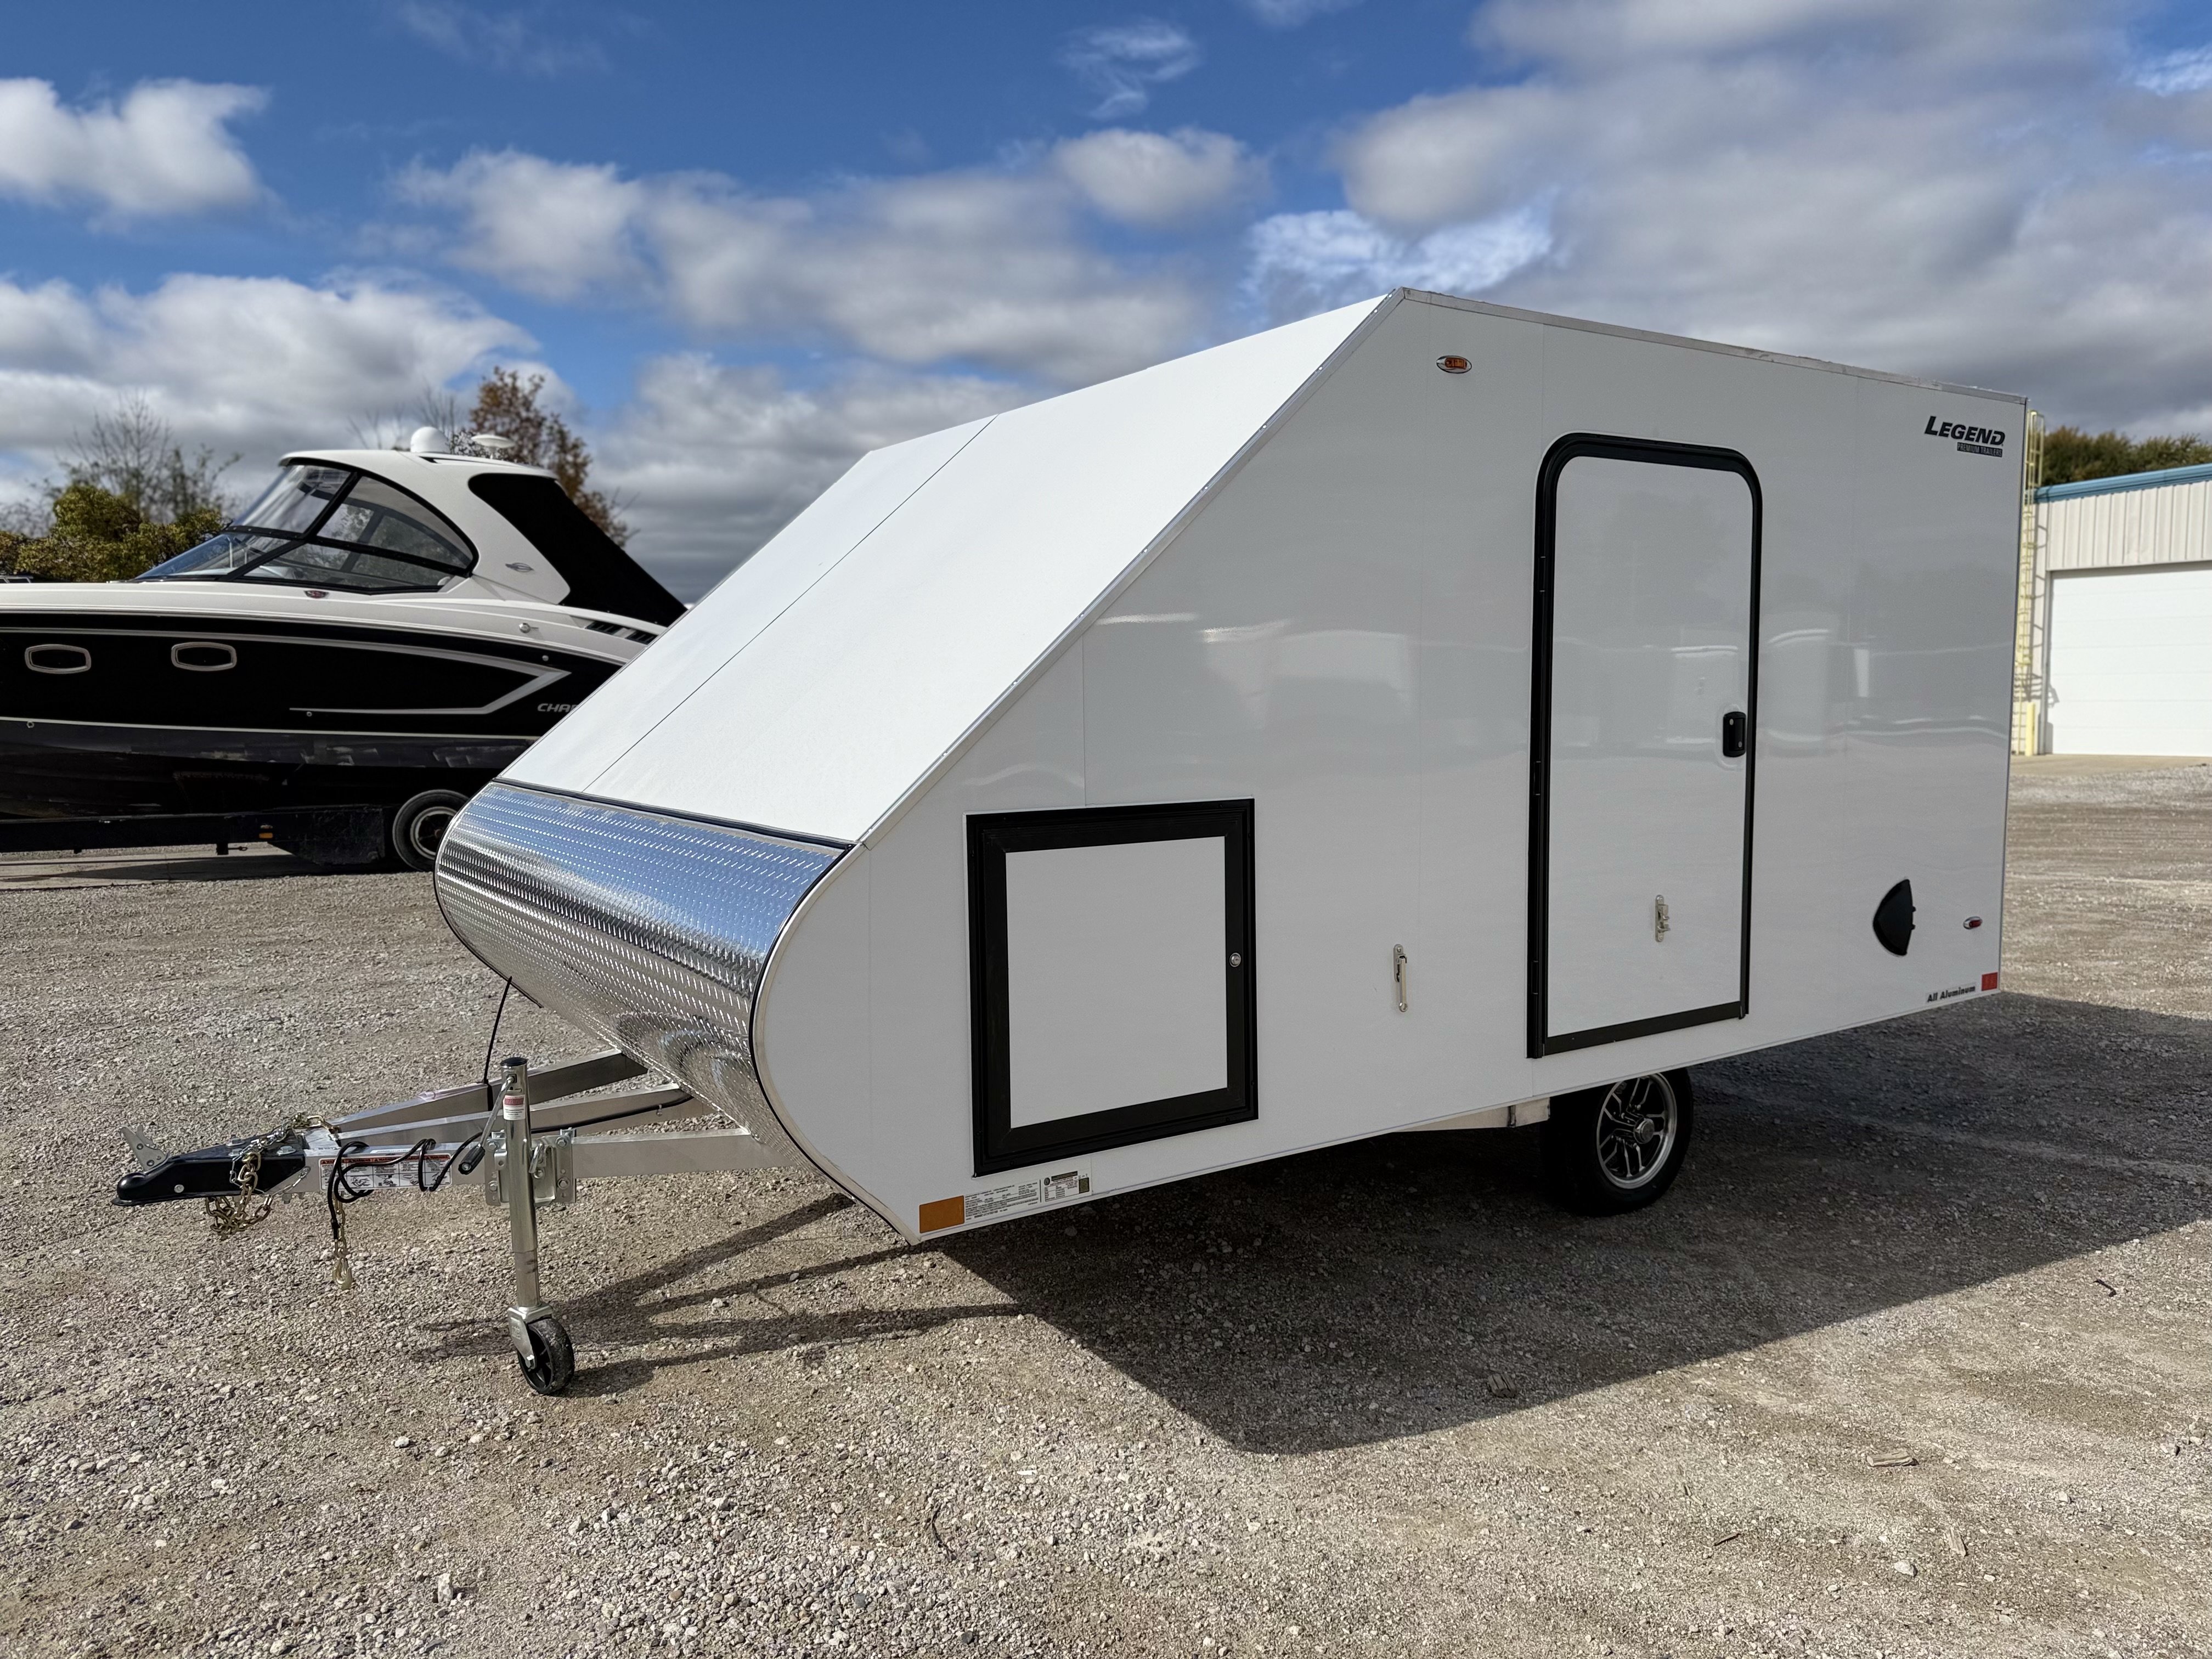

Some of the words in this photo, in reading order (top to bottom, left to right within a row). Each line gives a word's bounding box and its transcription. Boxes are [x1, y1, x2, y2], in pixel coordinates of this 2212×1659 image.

[1925, 415, 2005, 445] LEGEND
[1957, 443, 1980, 454] PREMIUM
[1980, 446, 2002, 457] TRAILERS
[1927, 992, 1938, 1002] All
[1940, 986, 1976, 1000] Aluminum
